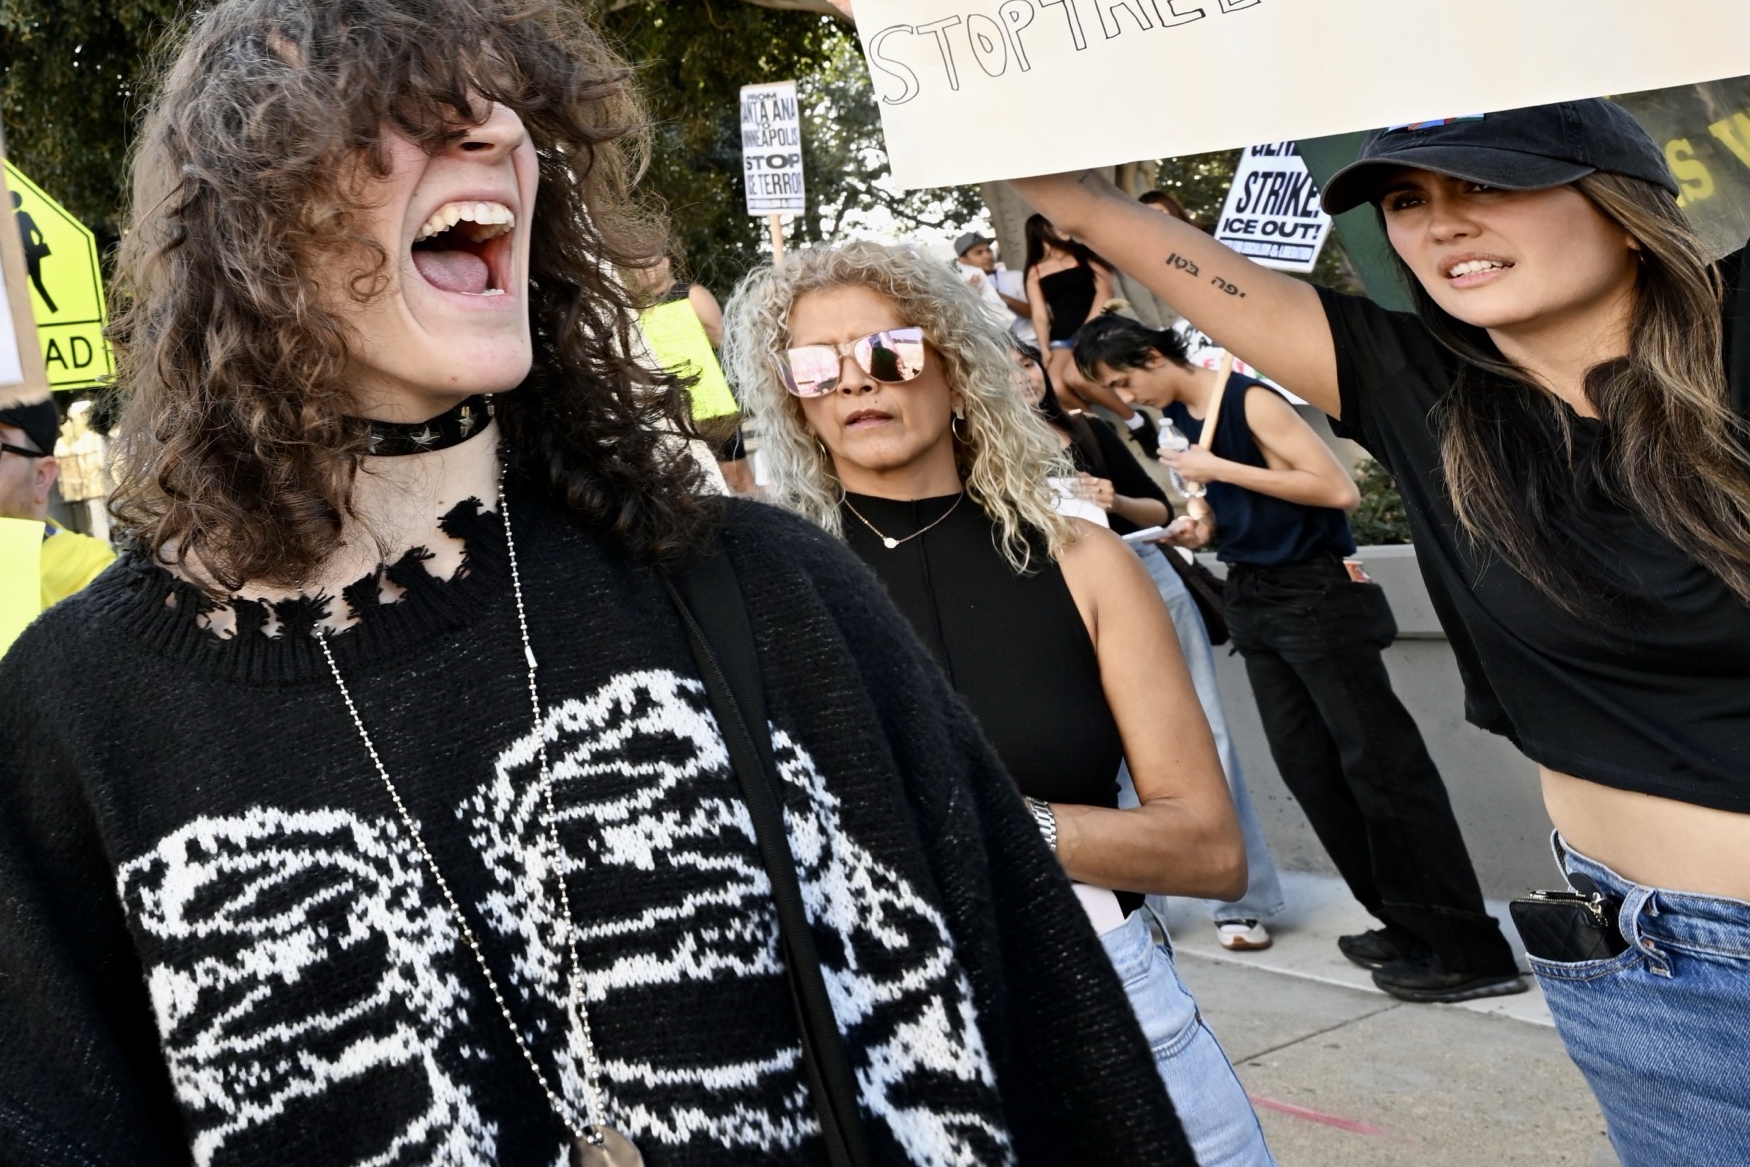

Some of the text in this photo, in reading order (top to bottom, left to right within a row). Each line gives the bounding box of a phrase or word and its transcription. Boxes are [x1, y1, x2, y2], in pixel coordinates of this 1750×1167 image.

[745, 153, 800, 171] STOP
[1222, 217, 1323, 240] ICE OUT!
